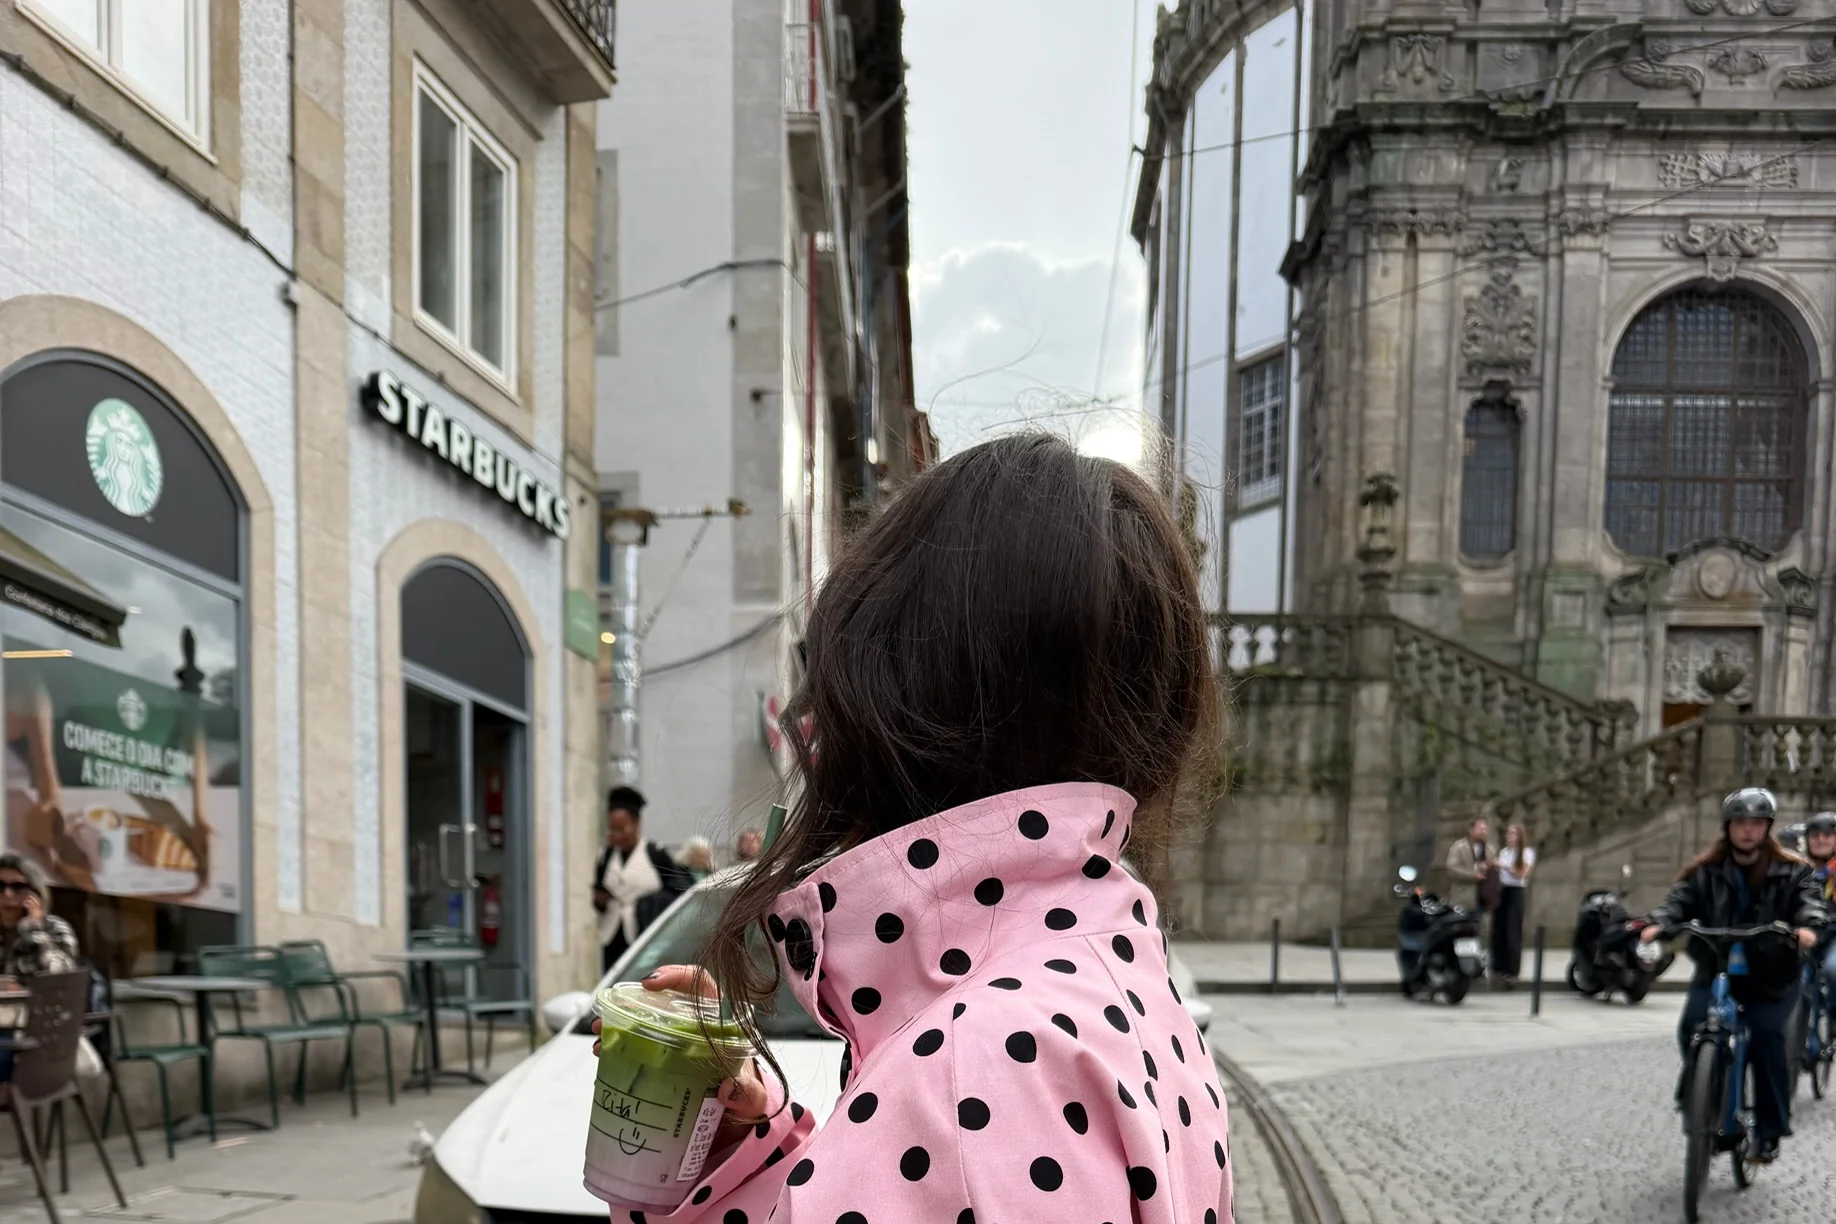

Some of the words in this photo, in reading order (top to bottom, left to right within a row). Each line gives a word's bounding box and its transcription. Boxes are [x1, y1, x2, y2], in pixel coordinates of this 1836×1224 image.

[376, 368, 571, 540] STARBUCKS
[63, 720, 124, 762] COMECE
[138, 740, 163, 771] DIA
[81, 755, 93, 784] A
[673, 1087, 692, 1138] STARBUCKS
